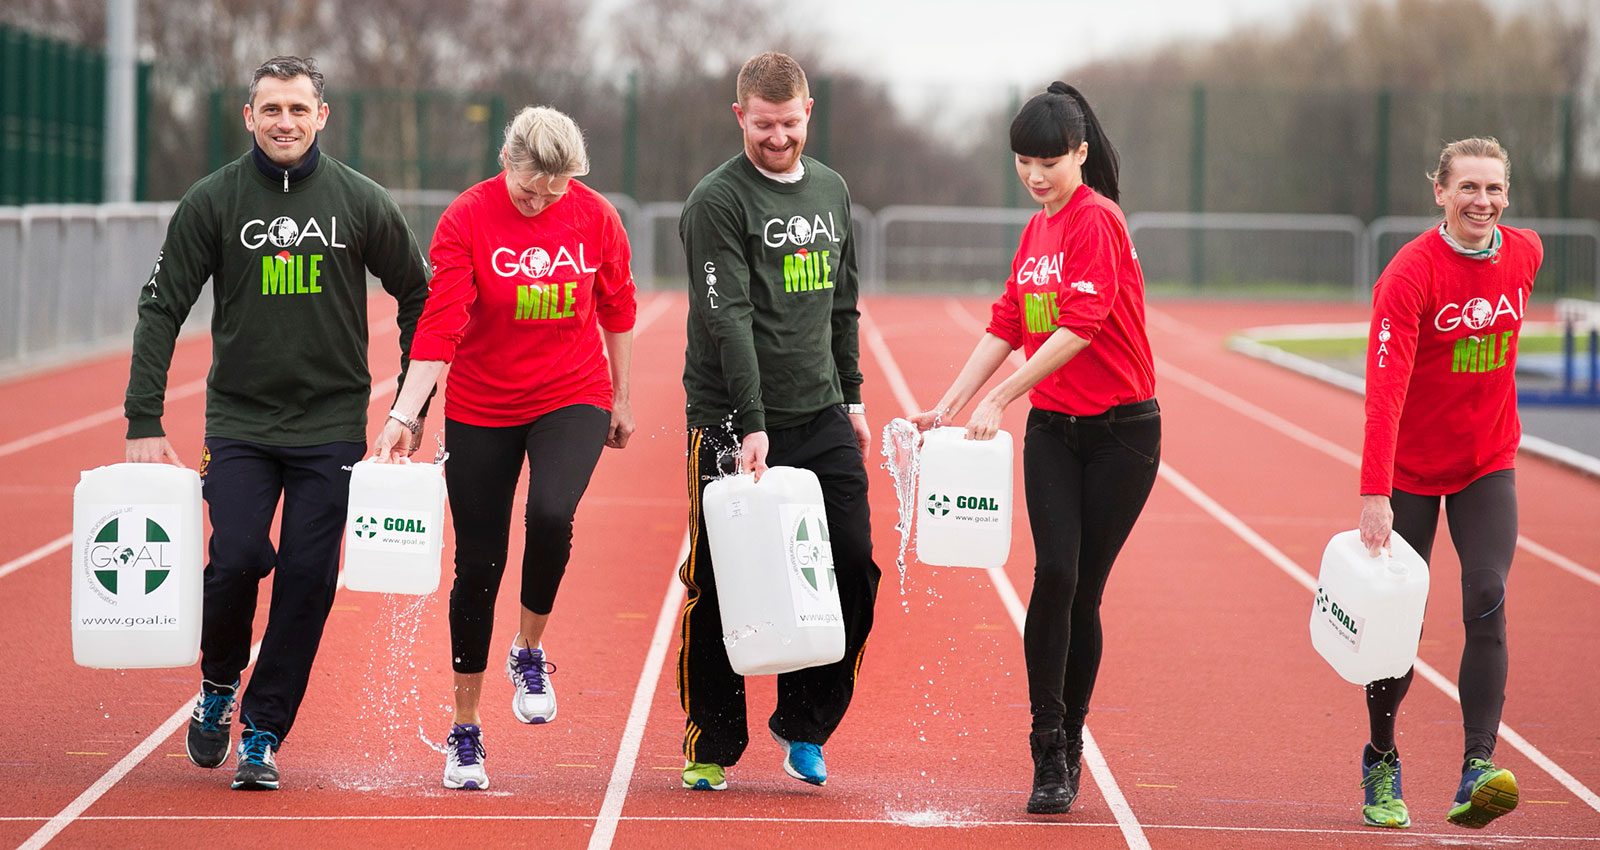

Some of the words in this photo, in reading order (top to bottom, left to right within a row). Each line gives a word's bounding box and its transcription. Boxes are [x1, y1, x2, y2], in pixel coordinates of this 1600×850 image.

[240, 216, 346, 249] GOAL
[764, 212, 840, 248] GOAL
[262, 254, 323, 295] MILE
[491, 243, 597, 278] GOAL
[784, 250, 834, 293] MILE
[514, 282, 578, 320] MILE
[704, 262, 719, 309] GOAL
[1377, 318, 1391, 368] GOAL
[1452, 330, 1514, 373] MILE
[955, 515, 999, 523] www.goal.ie
[957, 495, 999, 511] GOAL
[382, 538, 426, 546] www.goal.ie
[383, 517, 426, 534] GOAL
[91, 544, 172, 568] GOAL
[82, 615, 177, 627] www.goal.ie
[1331, 602, 1358, 635] GOAL
